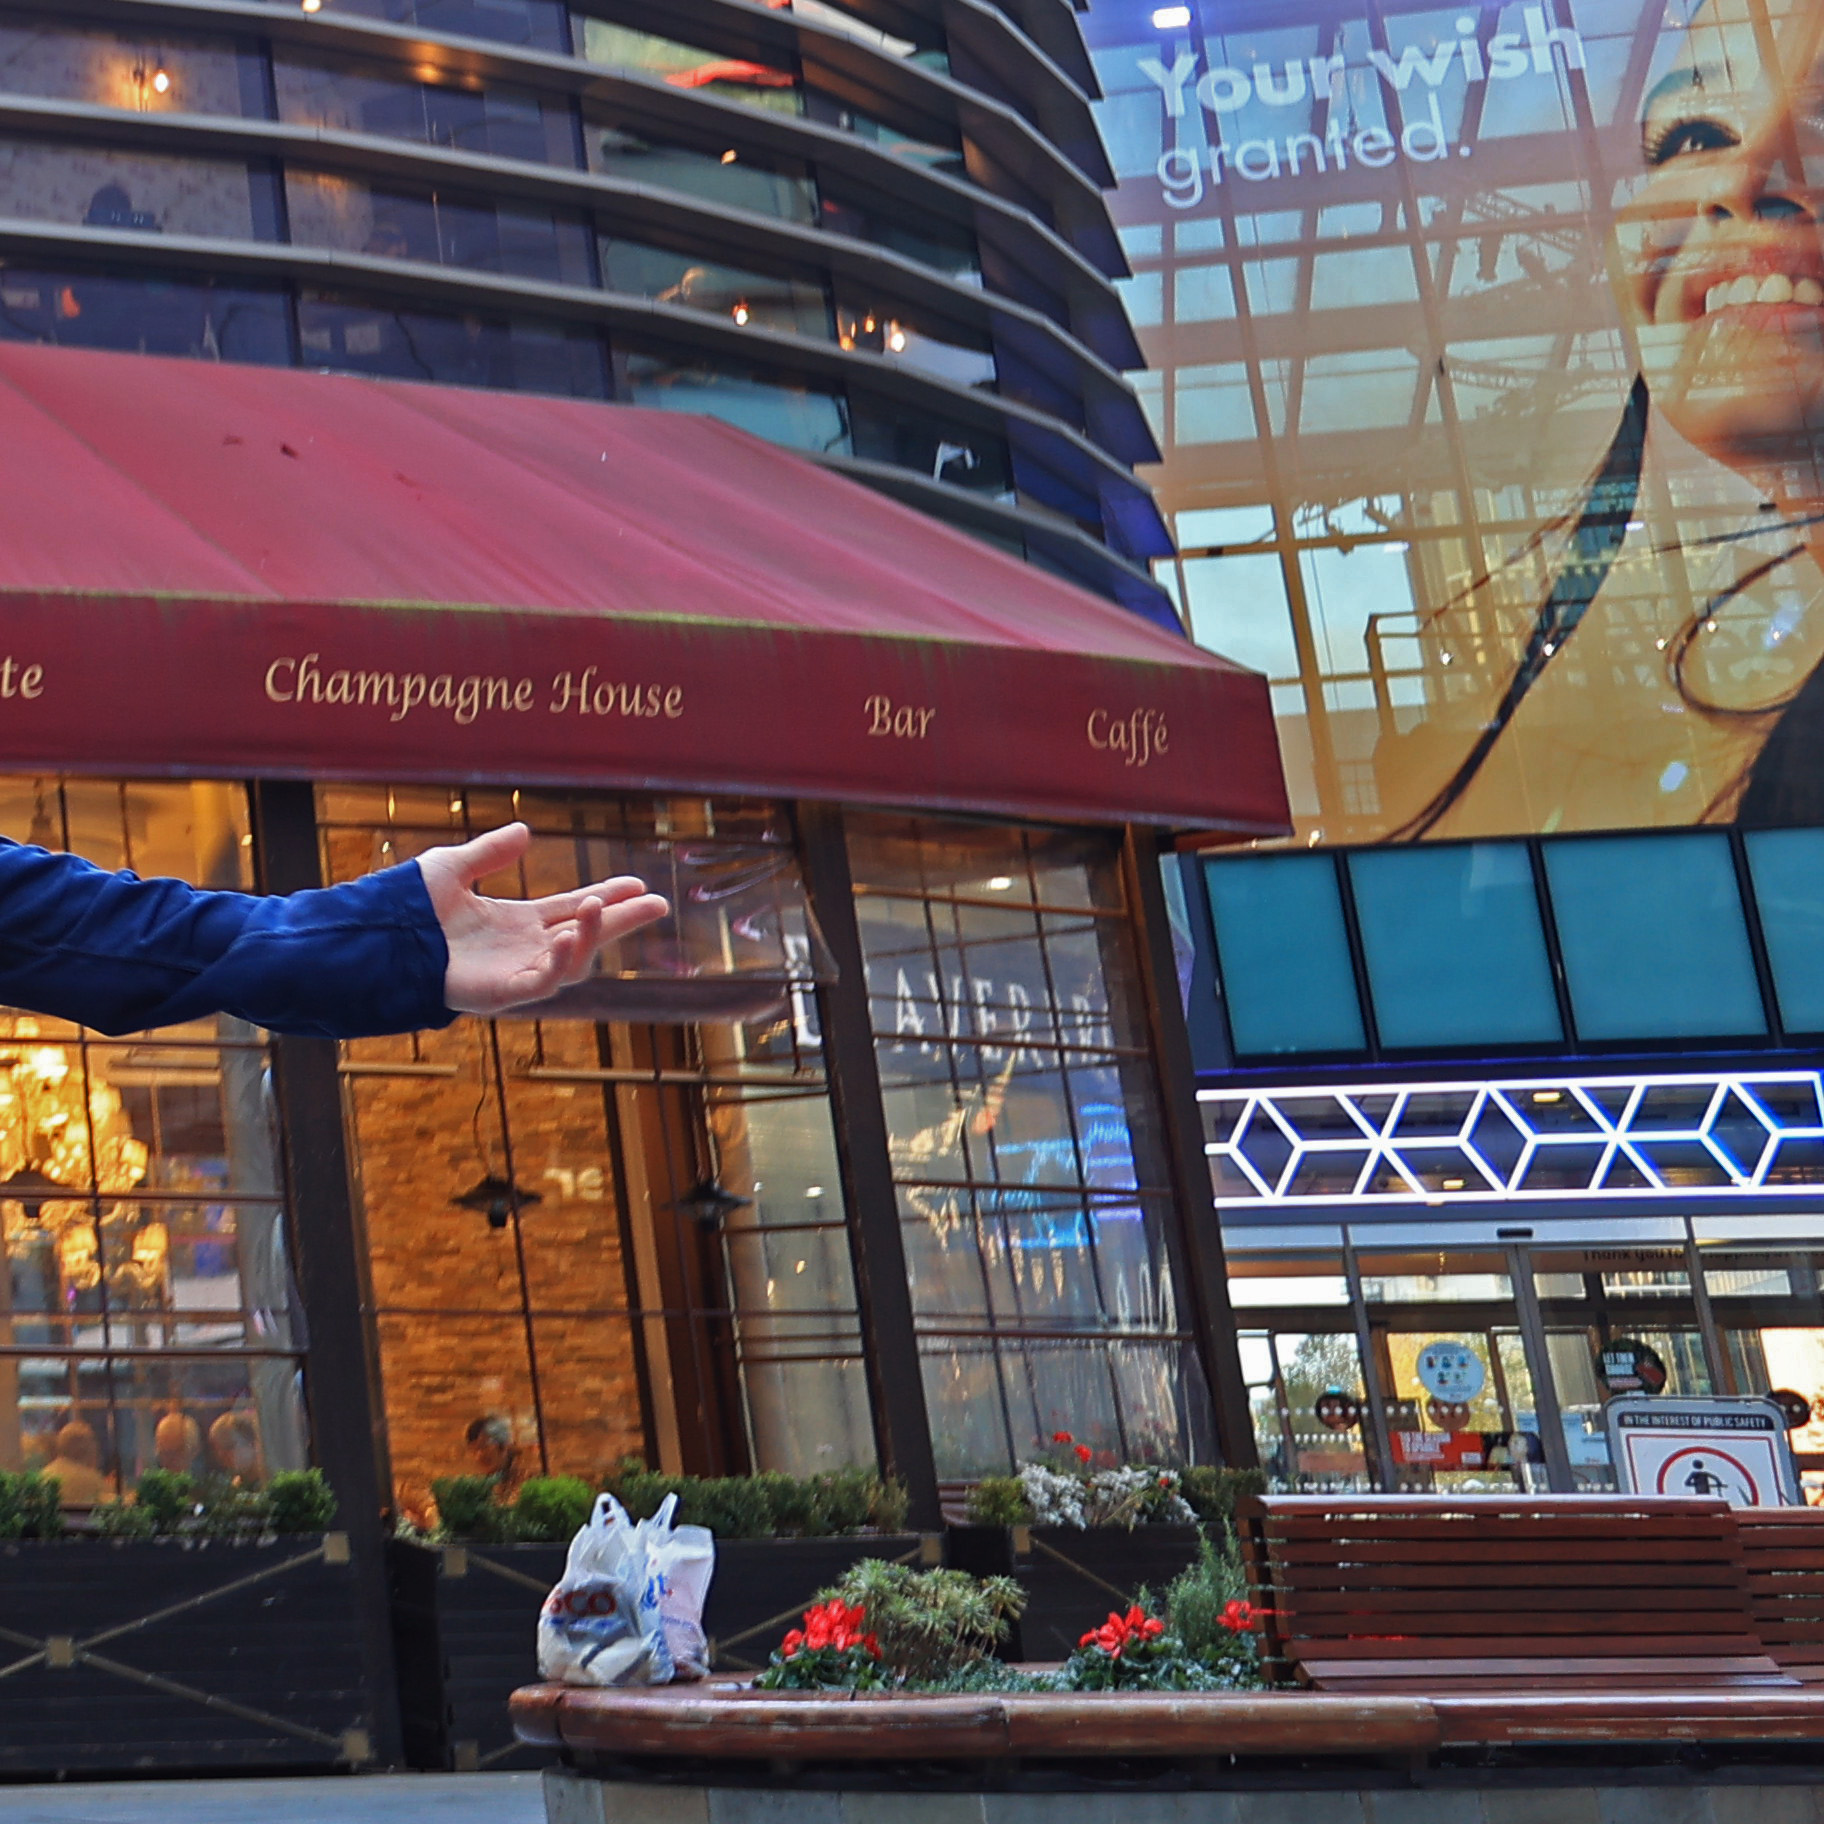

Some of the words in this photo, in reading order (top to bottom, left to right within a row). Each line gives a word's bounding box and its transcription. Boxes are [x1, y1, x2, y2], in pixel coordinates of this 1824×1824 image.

[1136, 52, 1345, 118] Your
[1366, 5, 1586, 92] wish
[1156, 91, 1472, 210] granted.
[264, 652, 535, 724] Champagne
[549, 665, 685, 720] House
[863, 693, 936, 739] Bar
[1086, 706, 1170, 768] Caffé
[1634, 1415, 1650, 1425] THE
[1651, 1415, 1690, 1426] INTEREST
[1703, 1416, 1733, 1427] PUBLIC
[1734, 1416, 1767, 1428] SAFETY
